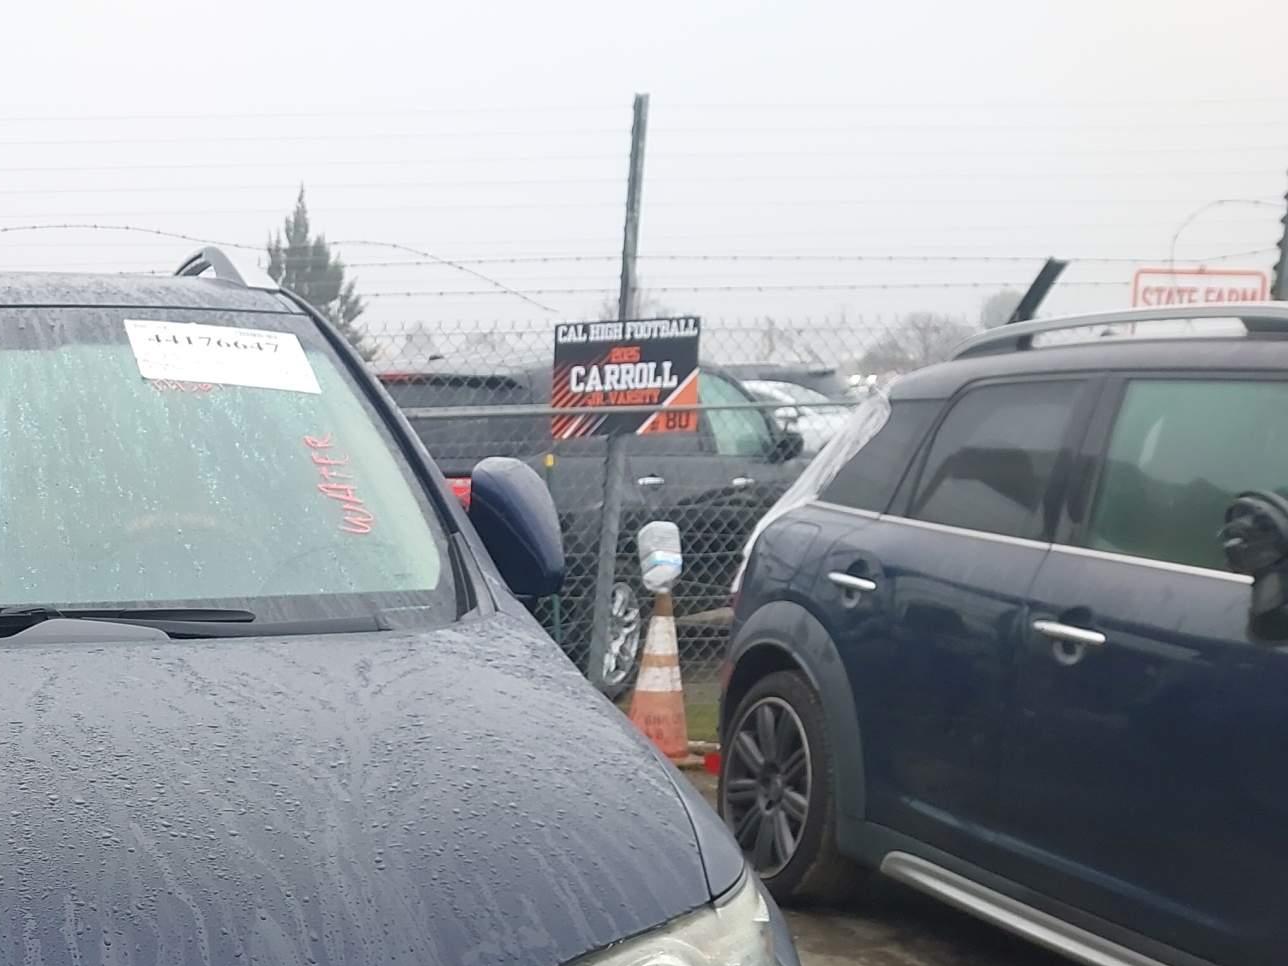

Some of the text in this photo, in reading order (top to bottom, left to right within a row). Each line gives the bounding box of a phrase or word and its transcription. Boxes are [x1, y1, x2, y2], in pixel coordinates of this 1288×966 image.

[557, 318, 698, 343] CAL HIGH FOOTBALL
[570, 361, 678, 392] CARROLL
[665, 411, 690, 430] 80
